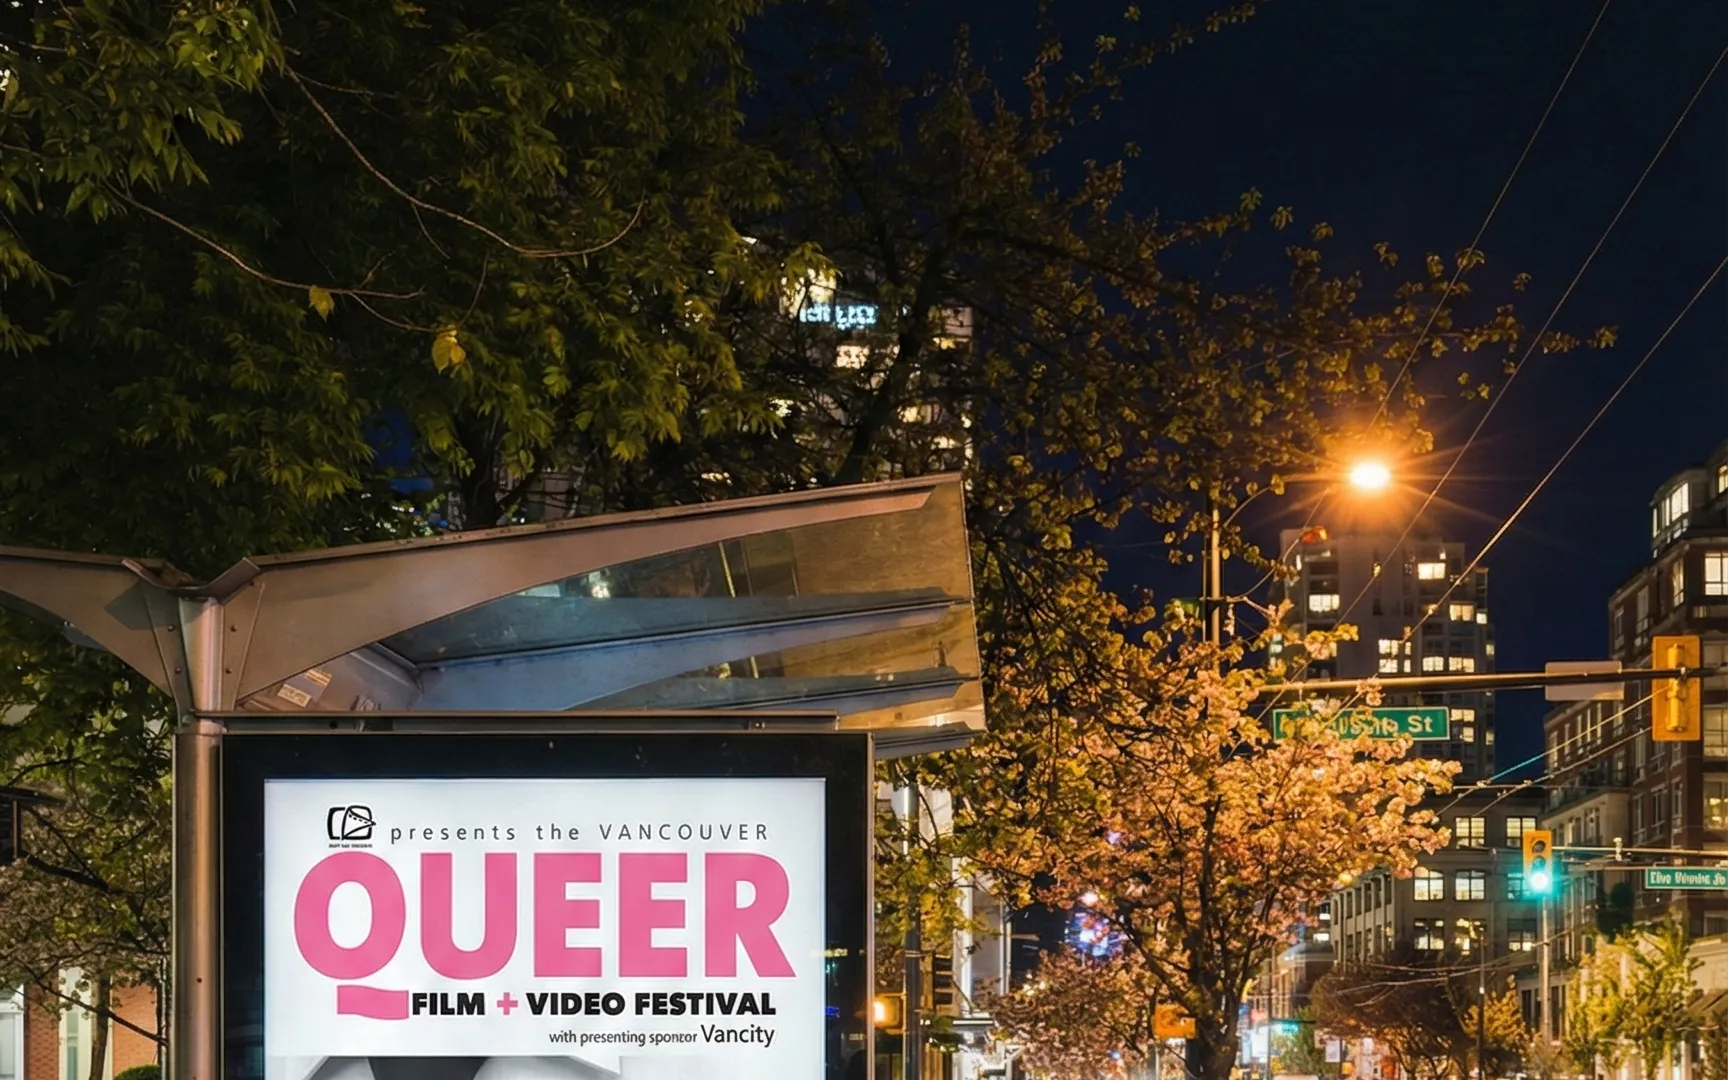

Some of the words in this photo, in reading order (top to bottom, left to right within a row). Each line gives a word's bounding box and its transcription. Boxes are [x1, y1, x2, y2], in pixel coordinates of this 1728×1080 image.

[1407, 714, 1433, 733] St
[390, 823, 516, 845] presents
[535, 822, 580, 841] the
[598, 823, 769, 841] VANCOUVER
[294, 851, 797, 1020] QUEER
[411, 991, 486, 1016] FILM
[526, 991, 625, 1016] VIDEO
[634, 991, 777, 1016] FESTIVAL
[549, 1030, 577, 1043] with
[580, 1030, 646, 1047] presenting
[700, 1023, 776, 1048] Vancity
